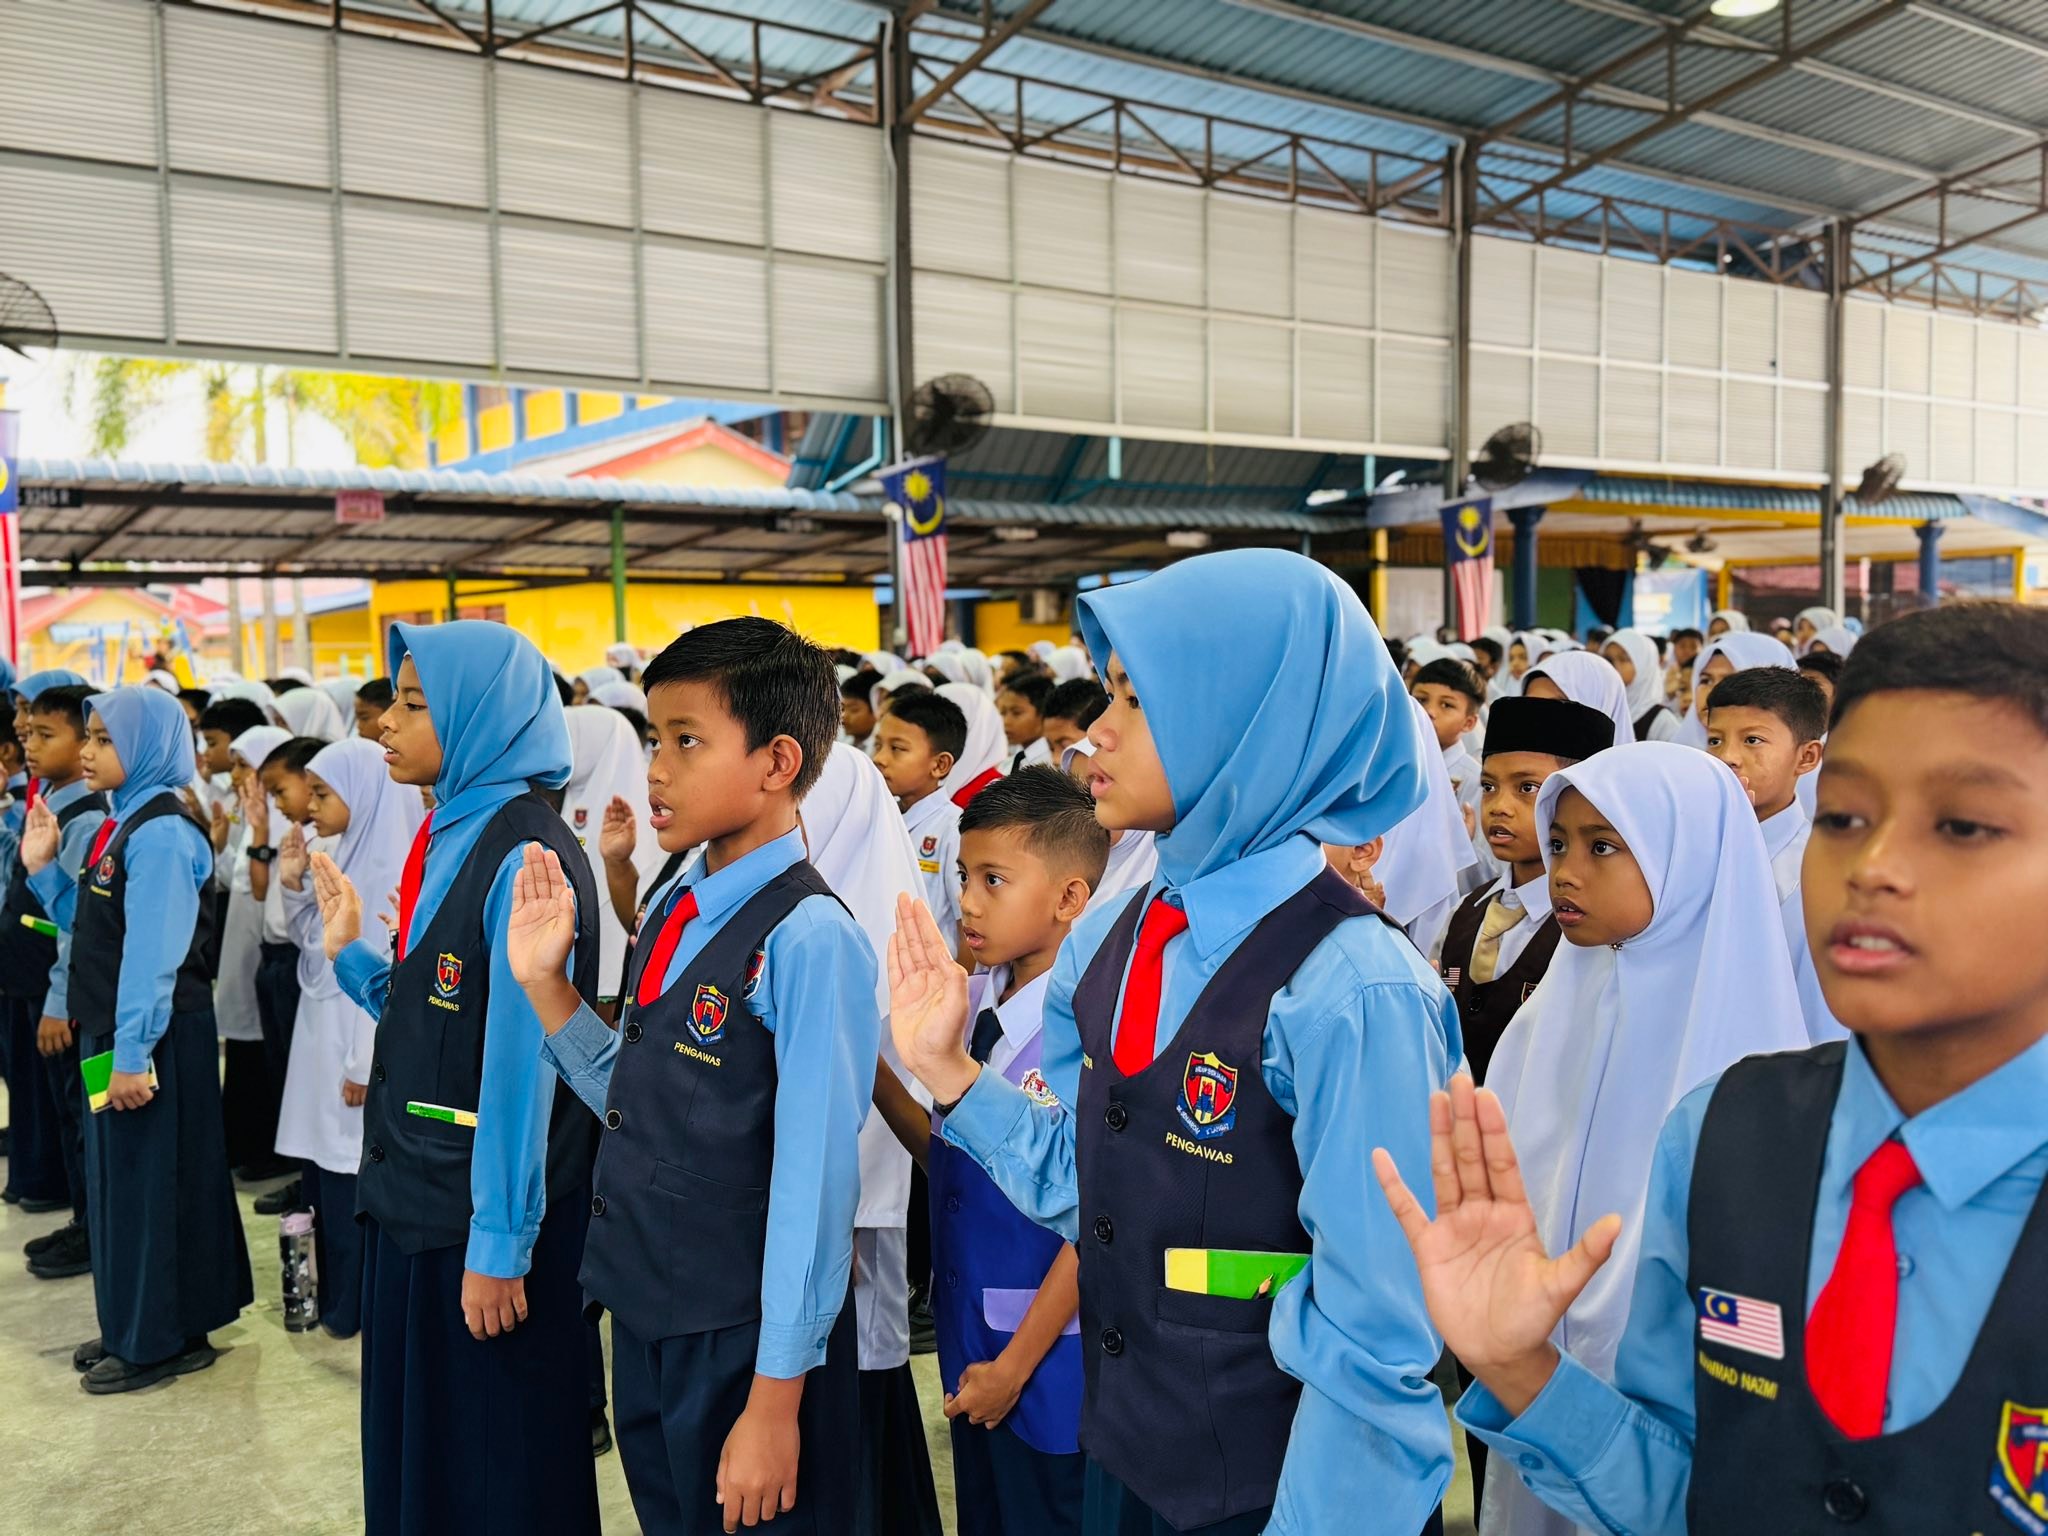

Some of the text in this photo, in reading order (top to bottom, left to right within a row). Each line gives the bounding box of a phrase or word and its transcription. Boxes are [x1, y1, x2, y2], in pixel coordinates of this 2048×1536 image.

[428, 995, 460, 1011] PENGAWAS
[673, 1041, 721, 1067] PENGAWAS
[1165, 1131, 1234, 1164] PENGAWAS
[1741, 1371, 1778, 1400] NAZMI
